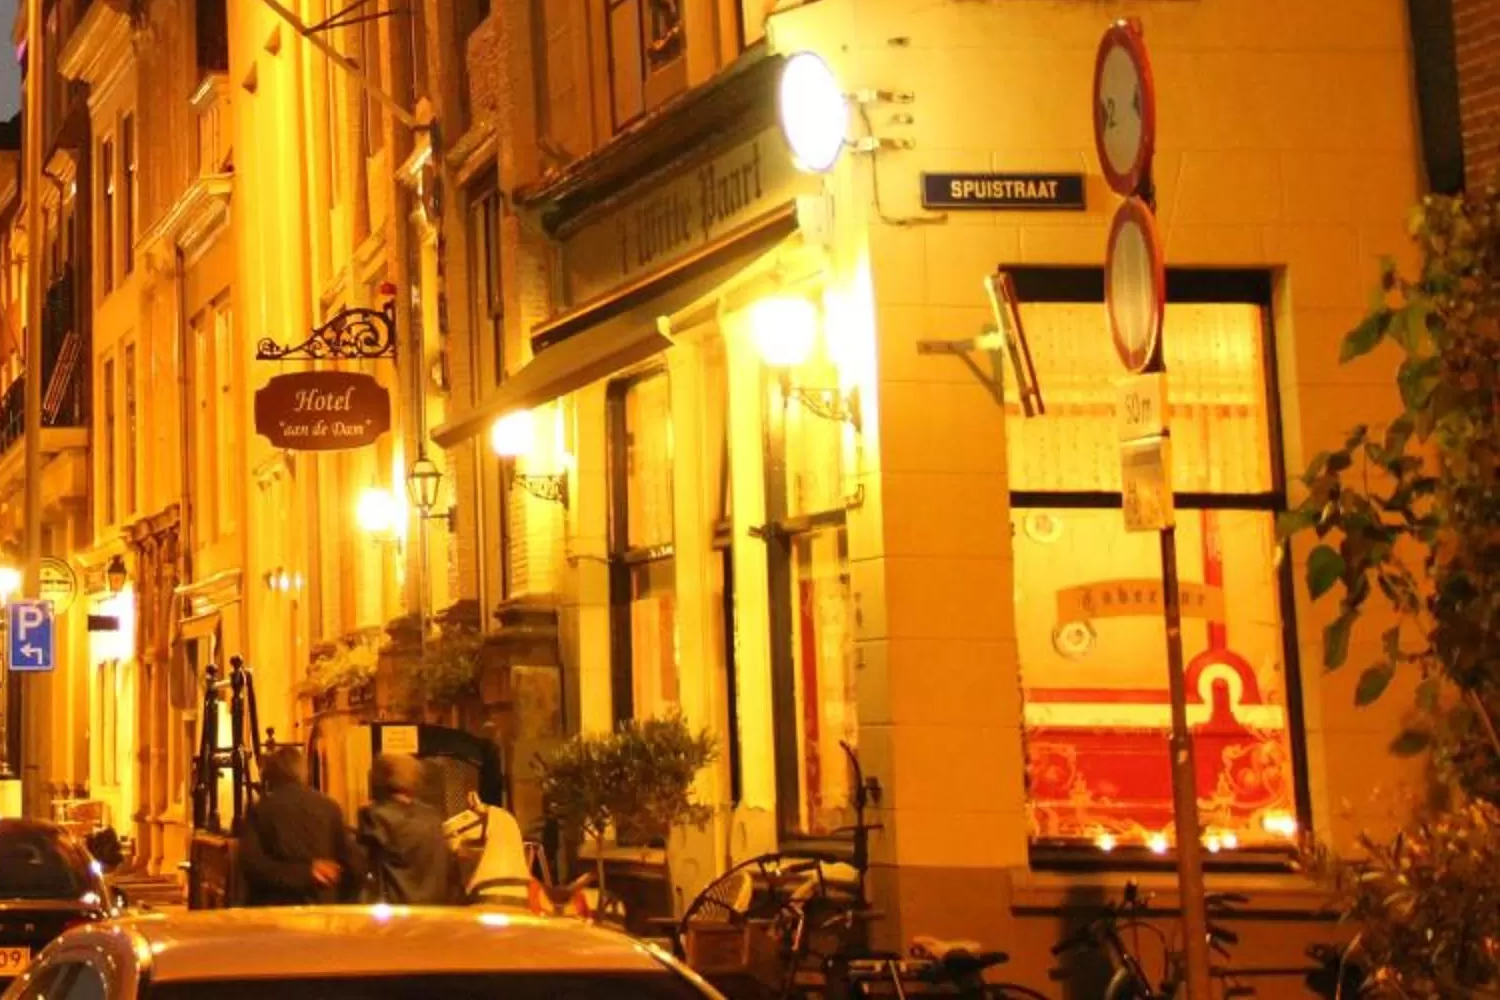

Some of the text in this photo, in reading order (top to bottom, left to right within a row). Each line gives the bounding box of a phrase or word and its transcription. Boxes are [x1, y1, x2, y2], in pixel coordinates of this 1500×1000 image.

[698, 142, 763, 242] Paart
[950, 179, 1059, 200] SPUISTRAAT
[293, 385, 357, 413] Hotel
[311, 419, 329, 437] de
[18, 605, 44, 641] P
